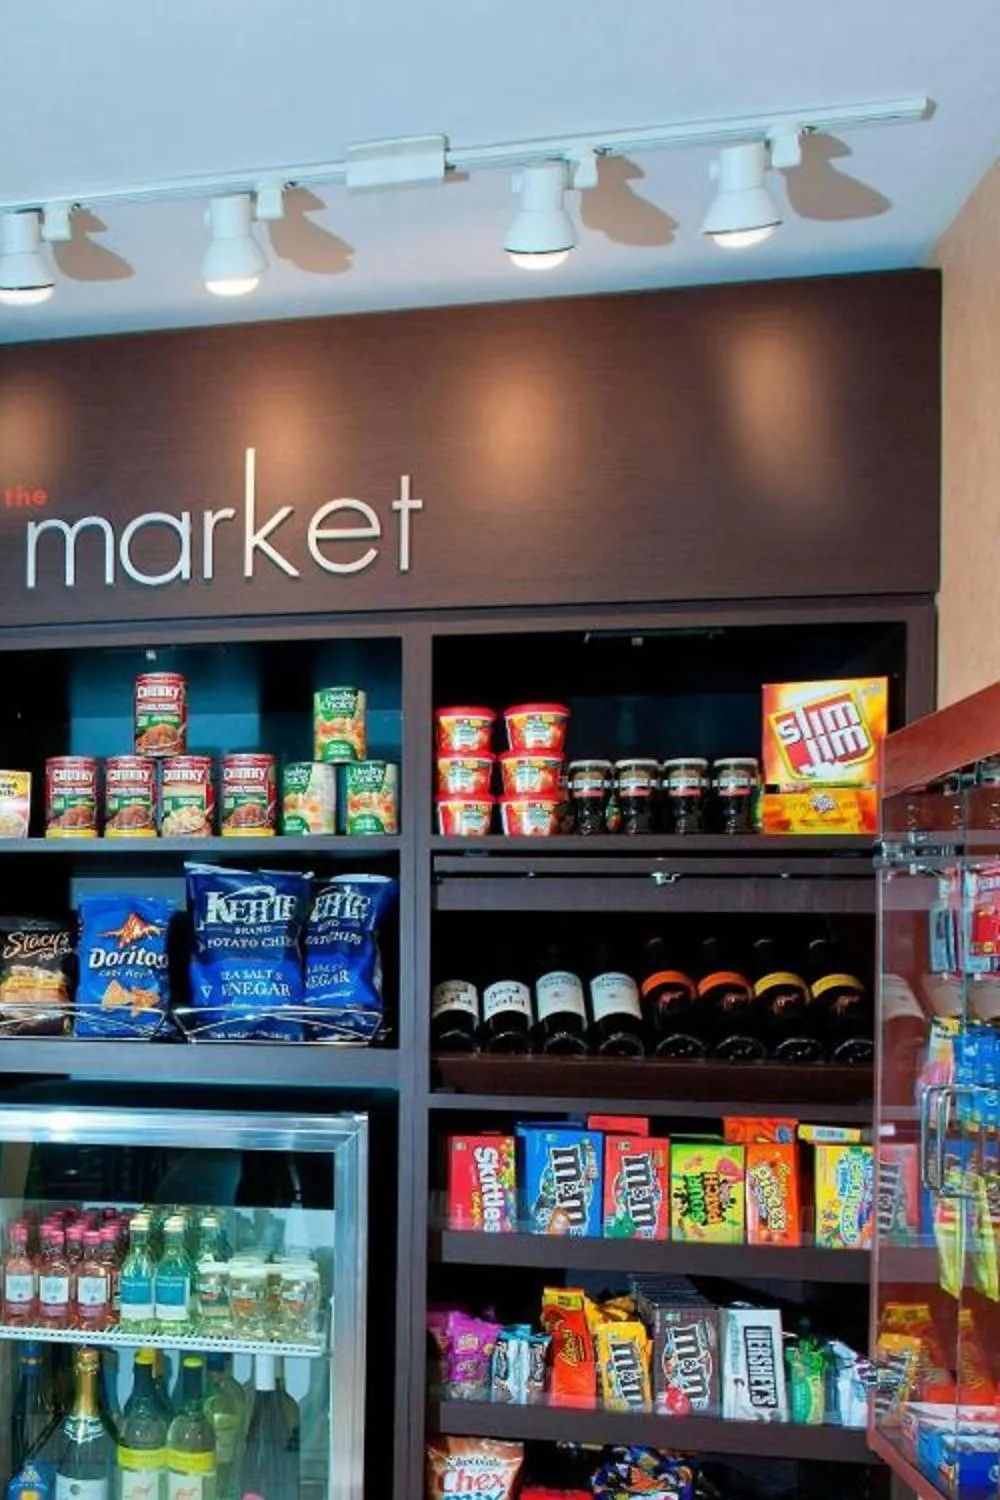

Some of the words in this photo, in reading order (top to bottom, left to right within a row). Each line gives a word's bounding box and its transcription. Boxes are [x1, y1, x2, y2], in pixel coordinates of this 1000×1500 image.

[4, 484, 48, 508] the
[26, 447, 423, 589] market
[3, 931, 70, 959] Stacy's
[744, 1327, 778, 1407] HERSHEY'S
[437, 1468, 506, 1493] Chex
